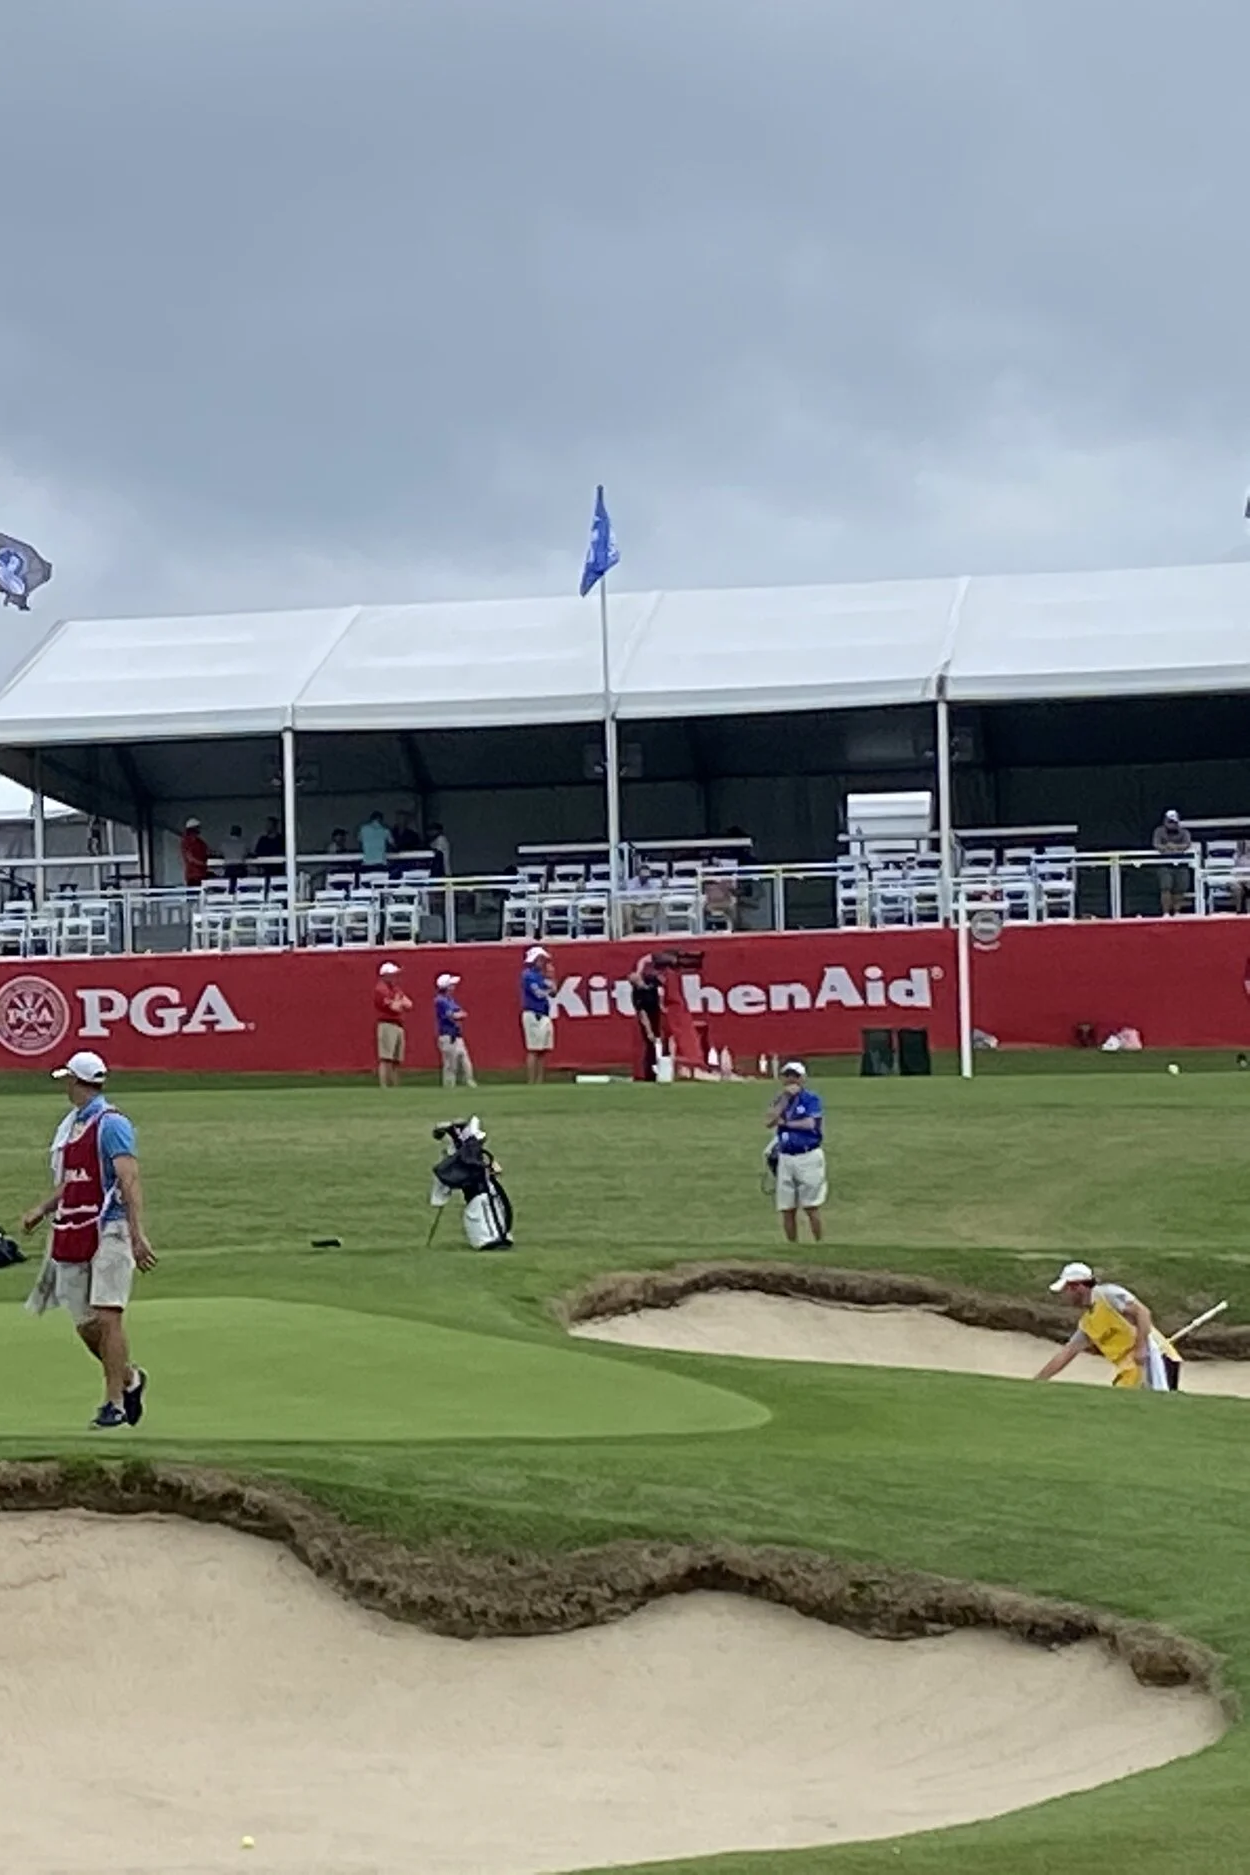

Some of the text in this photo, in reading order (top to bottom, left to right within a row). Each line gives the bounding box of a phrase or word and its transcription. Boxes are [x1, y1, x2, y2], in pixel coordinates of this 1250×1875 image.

[6, 1007, 55, 1025] PGA
[76, 984, 246, 1038] PGA
[551, 965, 932, 1020] KithenAid
